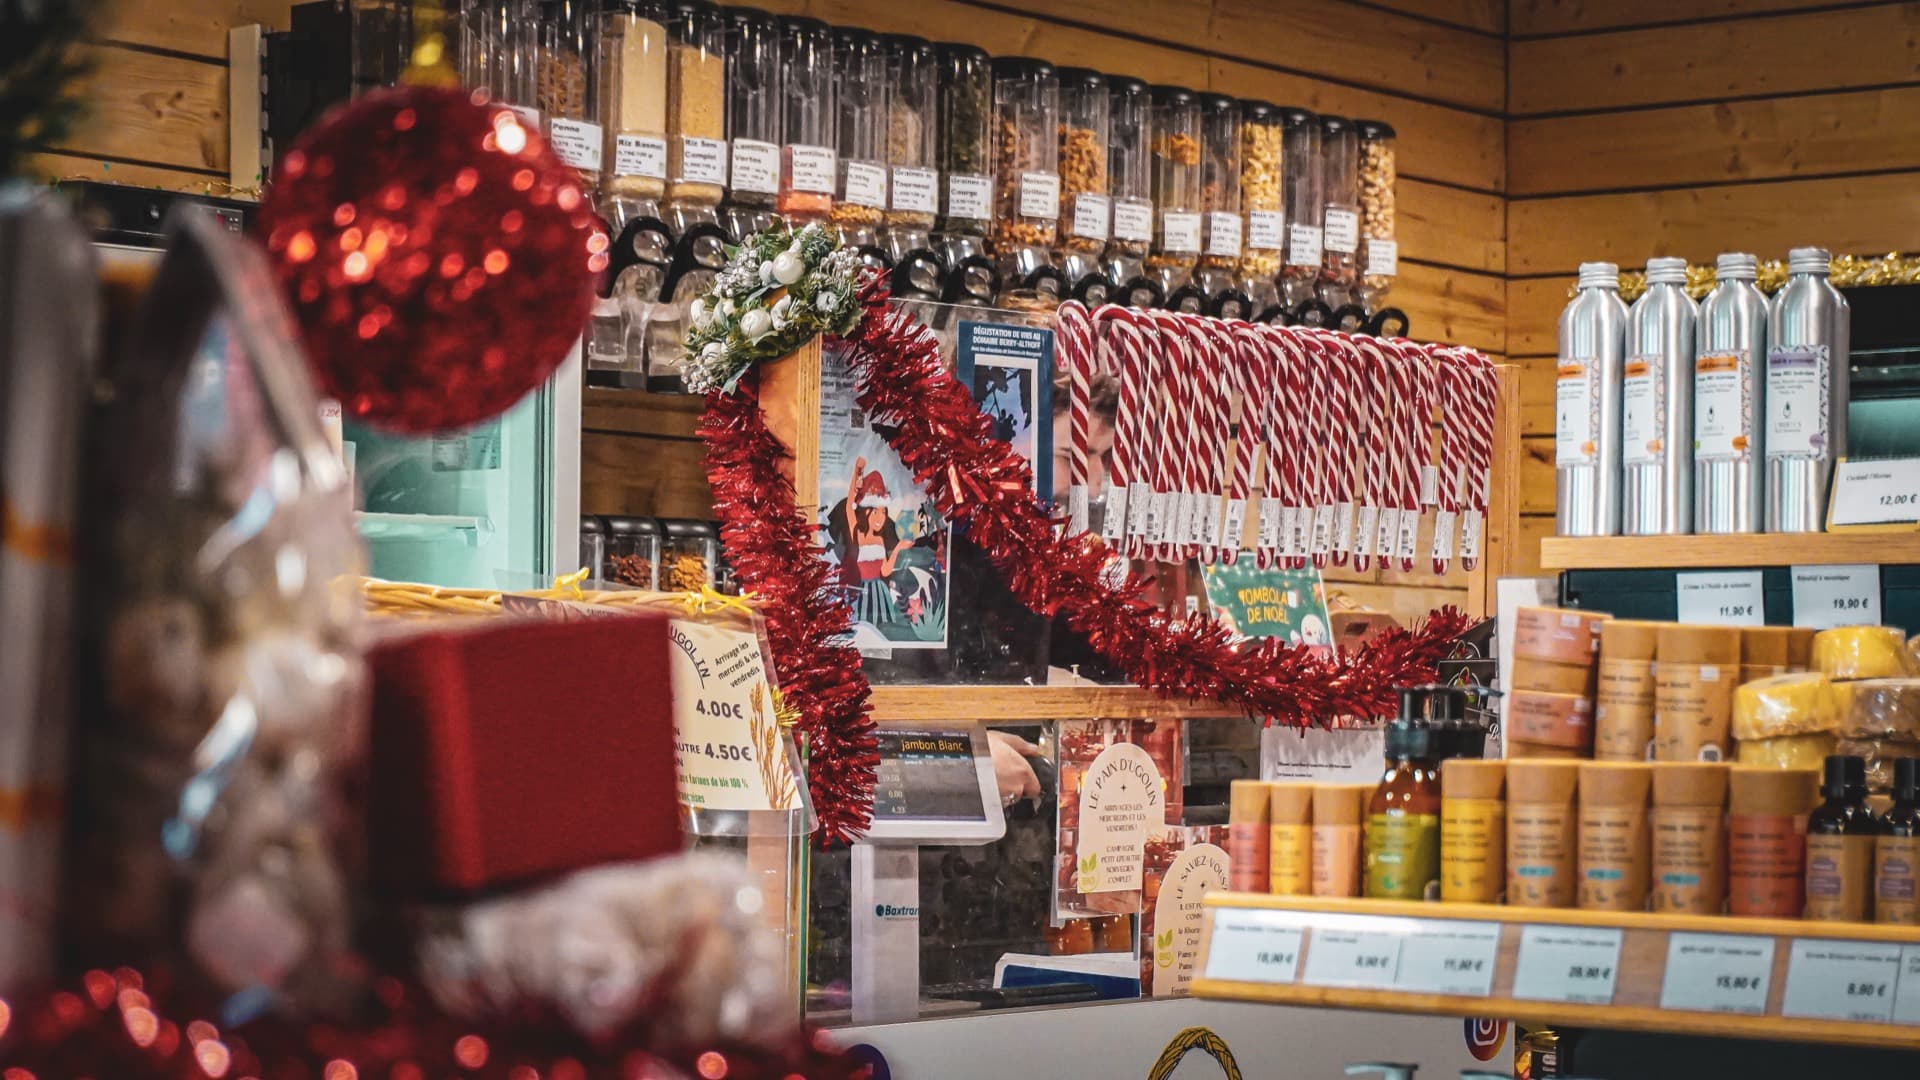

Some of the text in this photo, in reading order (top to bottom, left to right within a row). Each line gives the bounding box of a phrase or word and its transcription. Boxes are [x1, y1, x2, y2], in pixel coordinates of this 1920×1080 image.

[552, 123, 580, 133] Penne
[618, 138, 632, 148] Riz
[972, 336, 998, 345] DOMAINE
[973, 326, 1012, 338] DÉGUSTATION
[1012, 330, 1020, 338] DE
[1033, 332, 1040, 340] AU
[1910, 494, 1918, 504] €
[1238, 586, 1288, 606] TOMBOLA
[1833, 598, 1868, 609] 19,90 €
[1247, 607, 1262, 624] DE
[1719, 606, 1753, 616] 11,90 €
[715, 641, 749, 666] Arrivage les
[718, 650, 759, 680] mercredi & les
[730, 666, 760, 688] vendredis
[696, 699, 743, 719] 4.00€
[705, 743, 752, 761] 4.50€
[901, 740, 964, 751] jambon Blanc
[1088, 791, 1099, 810] LE
[1096, 760, 1118, 790] PAIN
